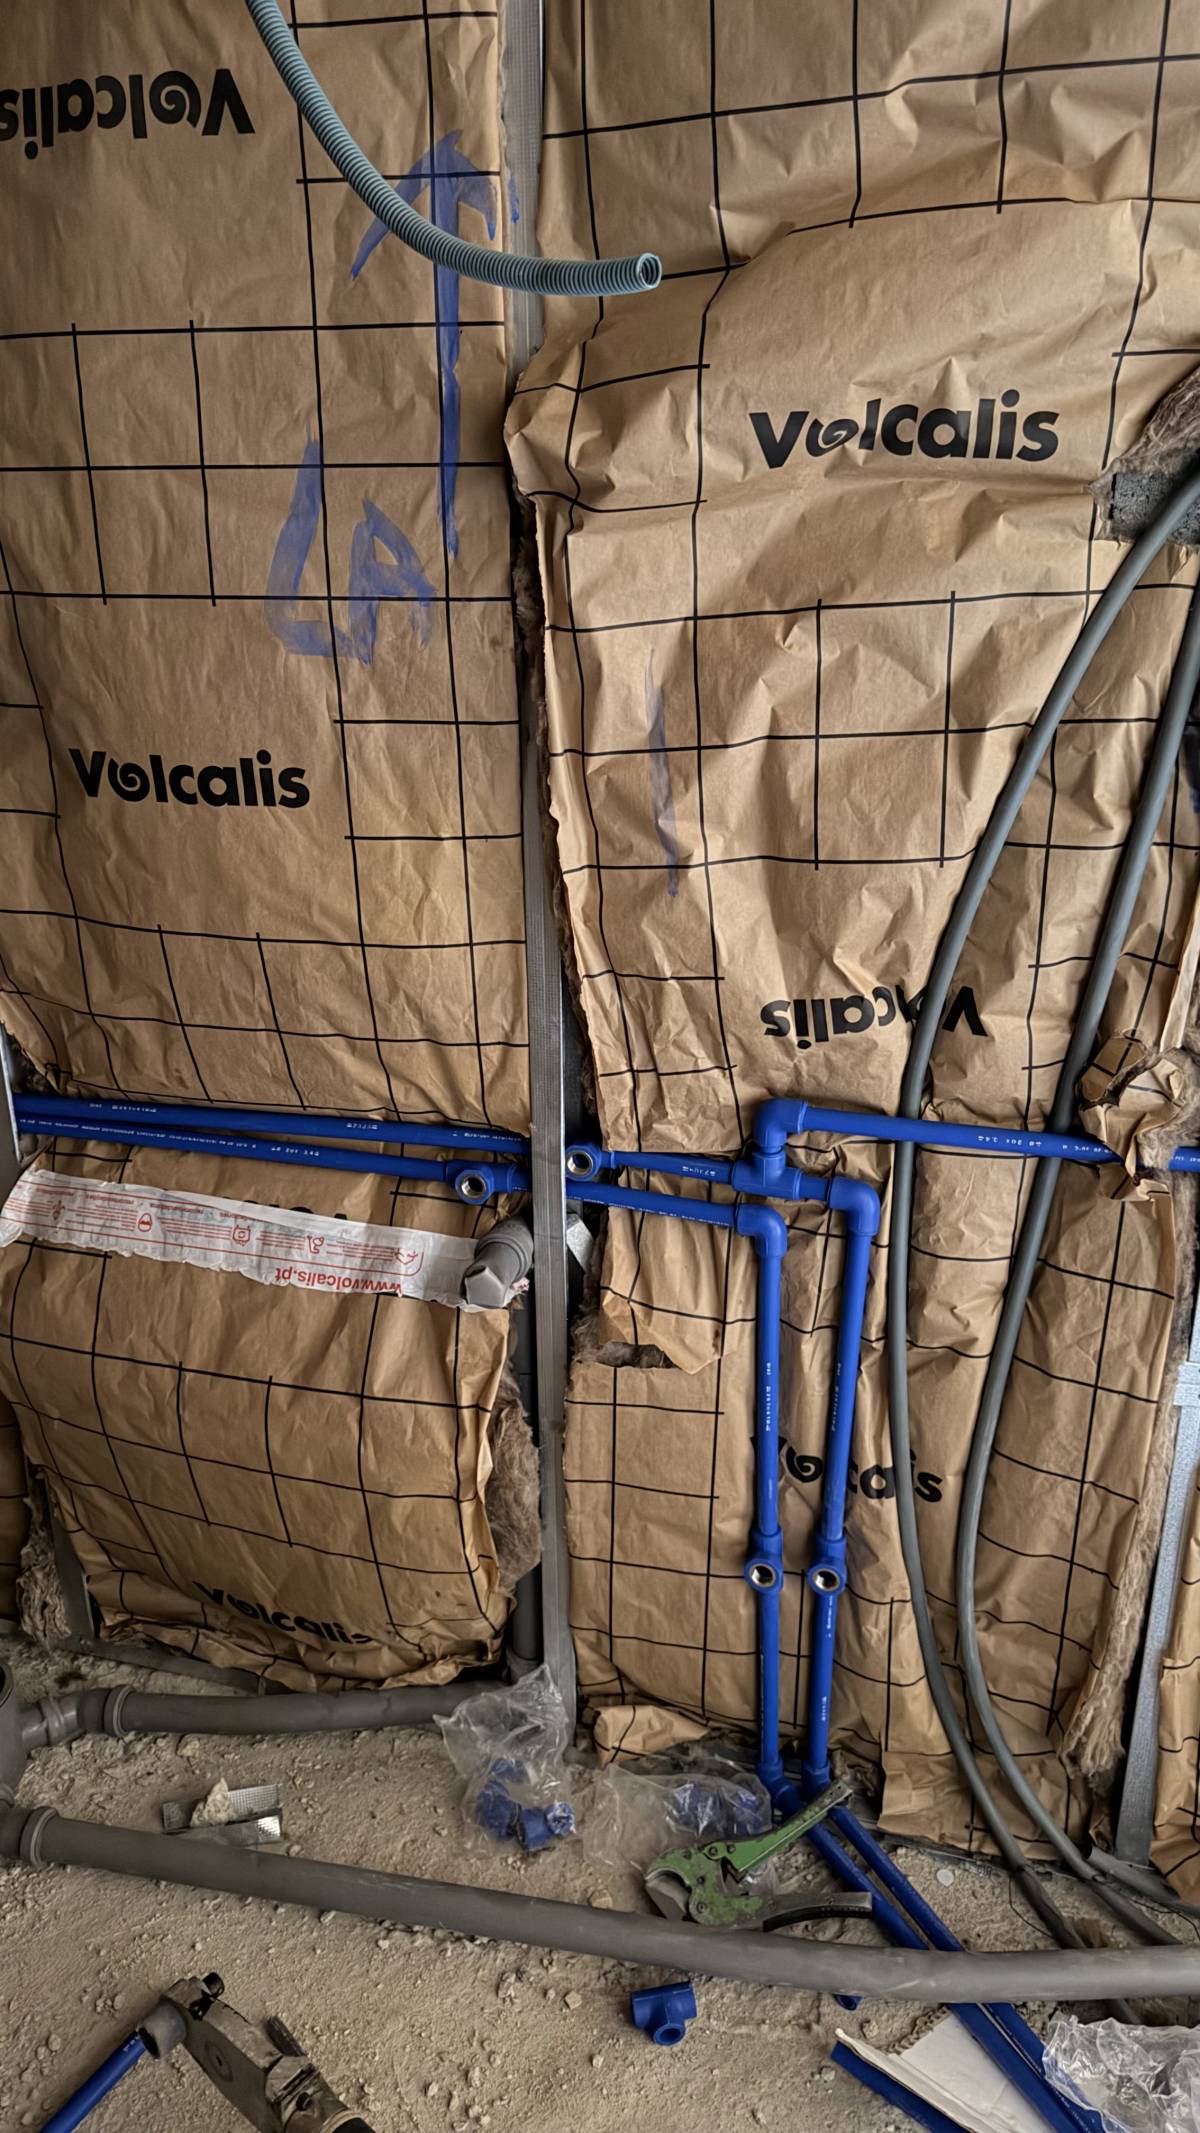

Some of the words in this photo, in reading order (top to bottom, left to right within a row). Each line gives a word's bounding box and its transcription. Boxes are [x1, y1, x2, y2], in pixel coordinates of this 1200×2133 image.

[749, 389, 1060, 469] Volcalis
[69, 749, 311, 808] Volcalis
[274, 1266, 403, 1296] www.volcalis.pt
